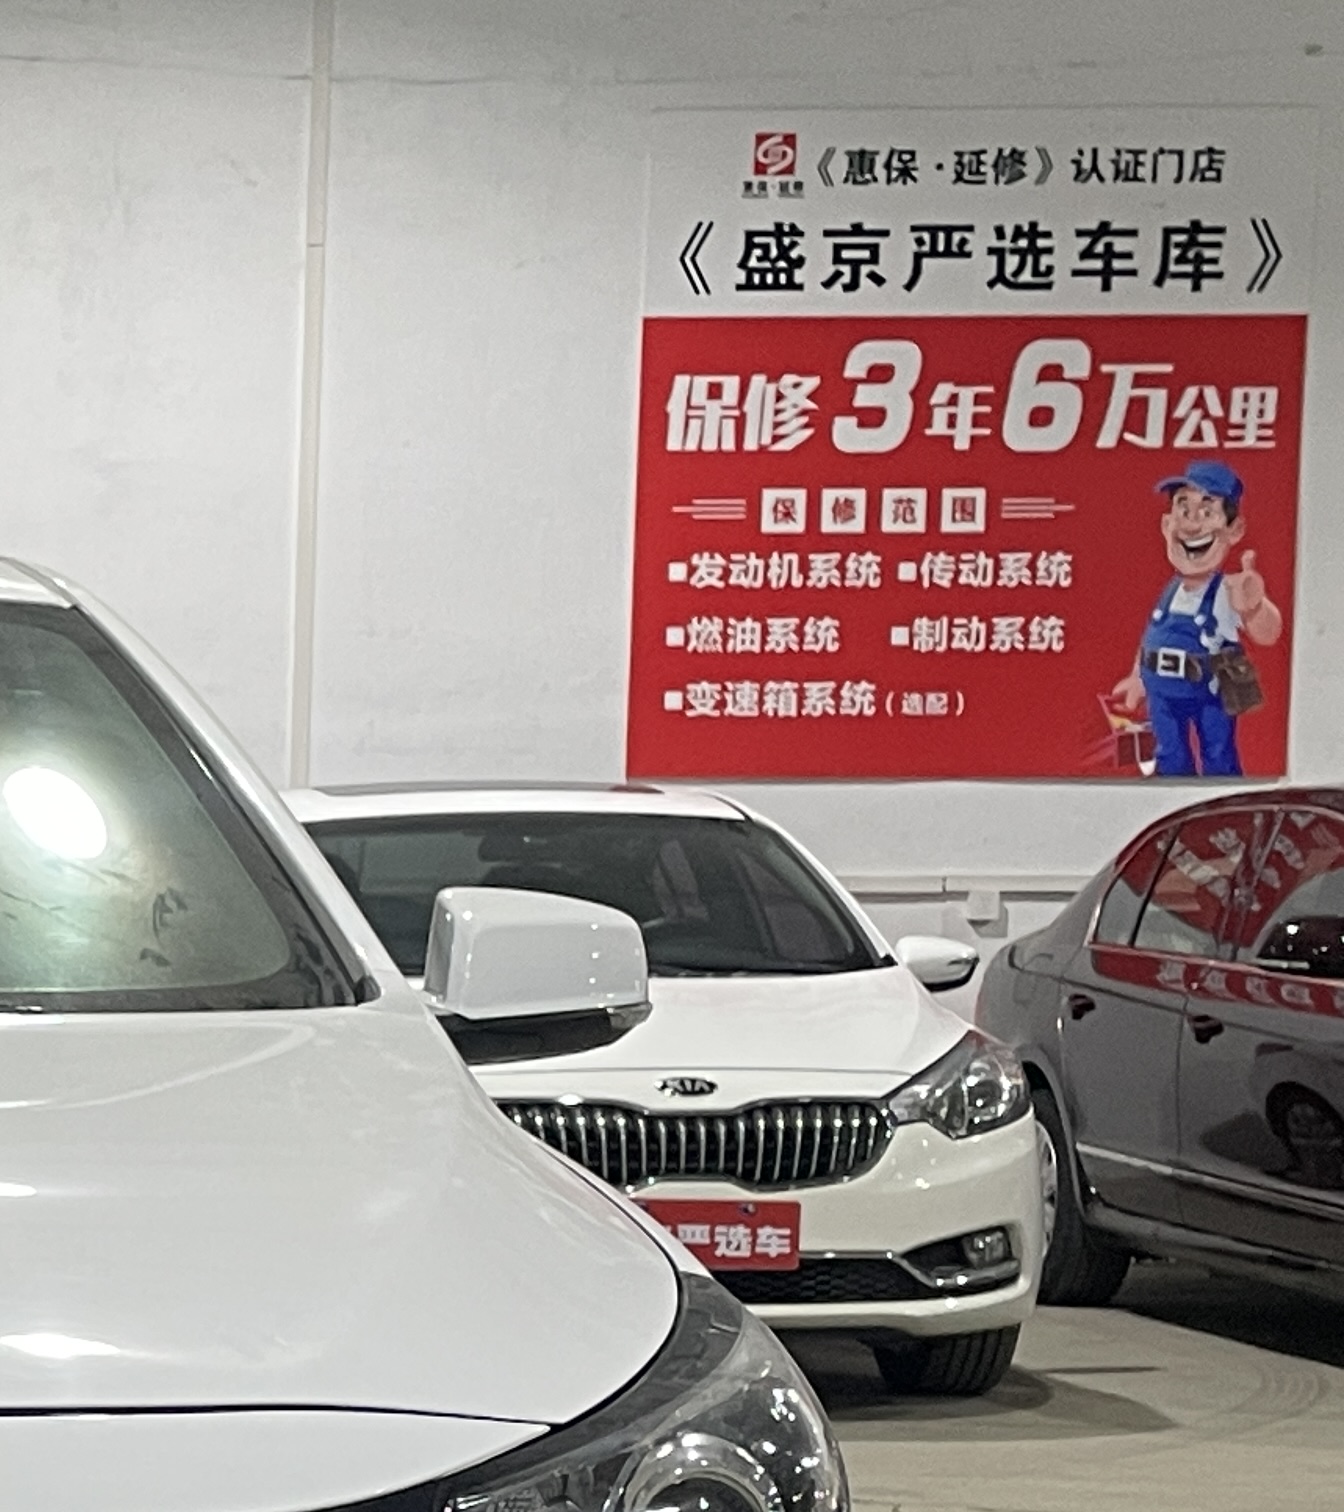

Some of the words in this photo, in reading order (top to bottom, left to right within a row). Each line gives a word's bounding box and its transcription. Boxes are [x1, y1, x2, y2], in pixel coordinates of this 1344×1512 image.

[679, 218, 1283, 296] 《盛京严选车库》
[666, 338, 1279, 454] 保修3年6万公里
[690, 552, 882, 589] 发动机系统
[921, 552, 1073, 589] 传动系统
[687, 616, 841, 653] 燃油系统
[913, 616, 1066, 653] 制动系统
[662, 1224, 792, 1258] 严选车
